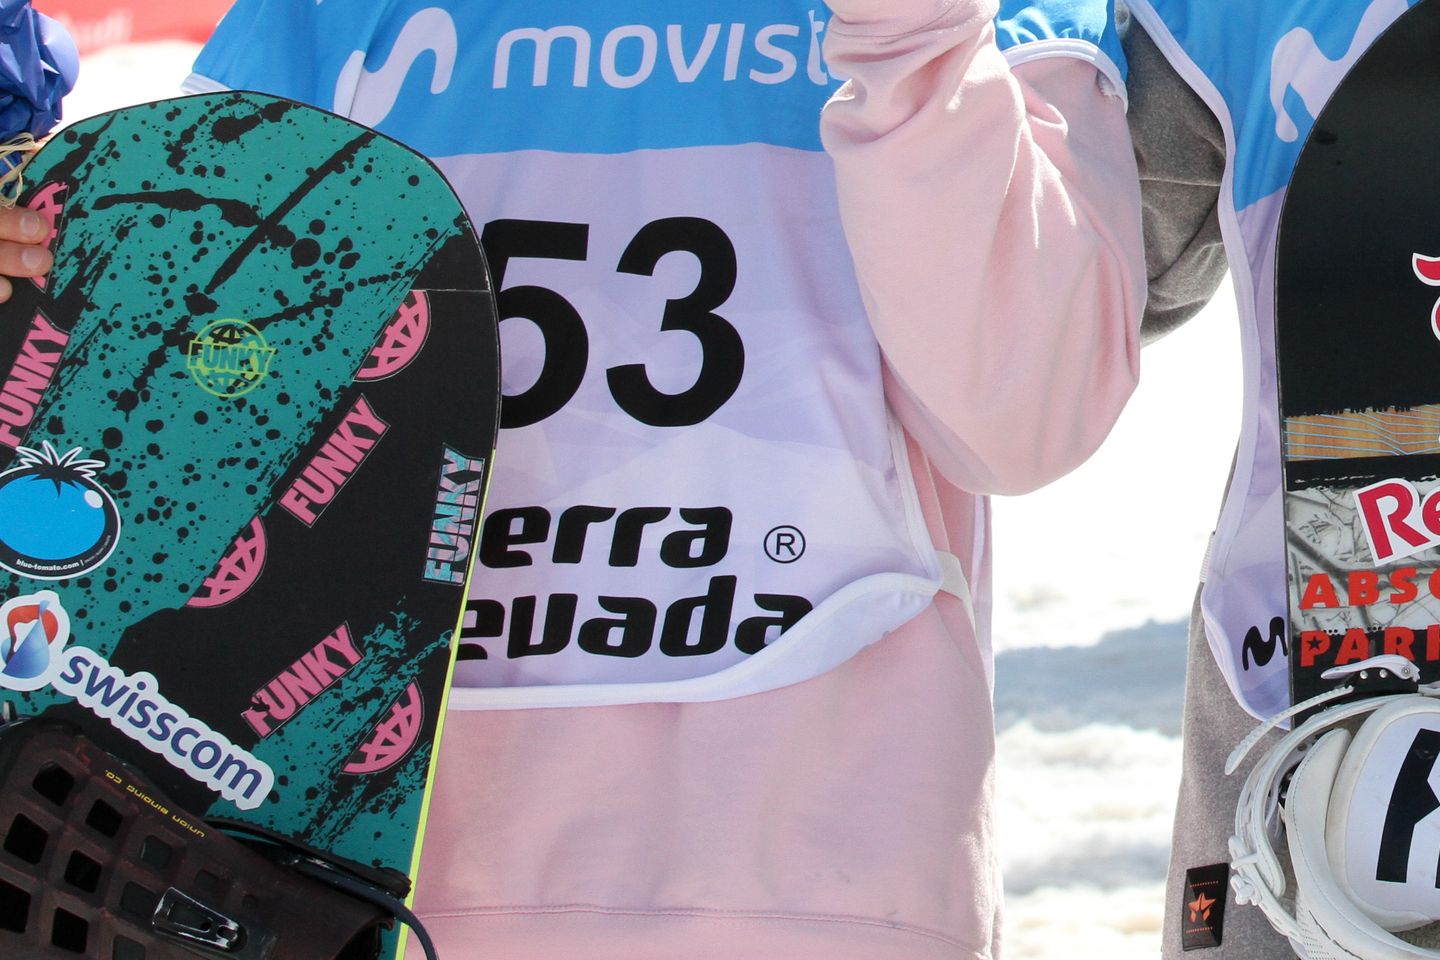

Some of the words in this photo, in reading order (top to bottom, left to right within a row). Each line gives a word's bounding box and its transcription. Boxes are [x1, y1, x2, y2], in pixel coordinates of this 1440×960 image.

[492, 10, 829, 90] movist
[480, 216, 746, 430] 53
[281, 397, 388, 526] FUNKY
[424, 447, 485, 584] FUNKY
[16, 558, 79, 571] blue-tomato.com
[479, 504, 733, 569] erra
[455, 575, 814, 660] evada
[60, 653, 263, 802] swisscom
[244, 625, 362, 738] FUNKY
